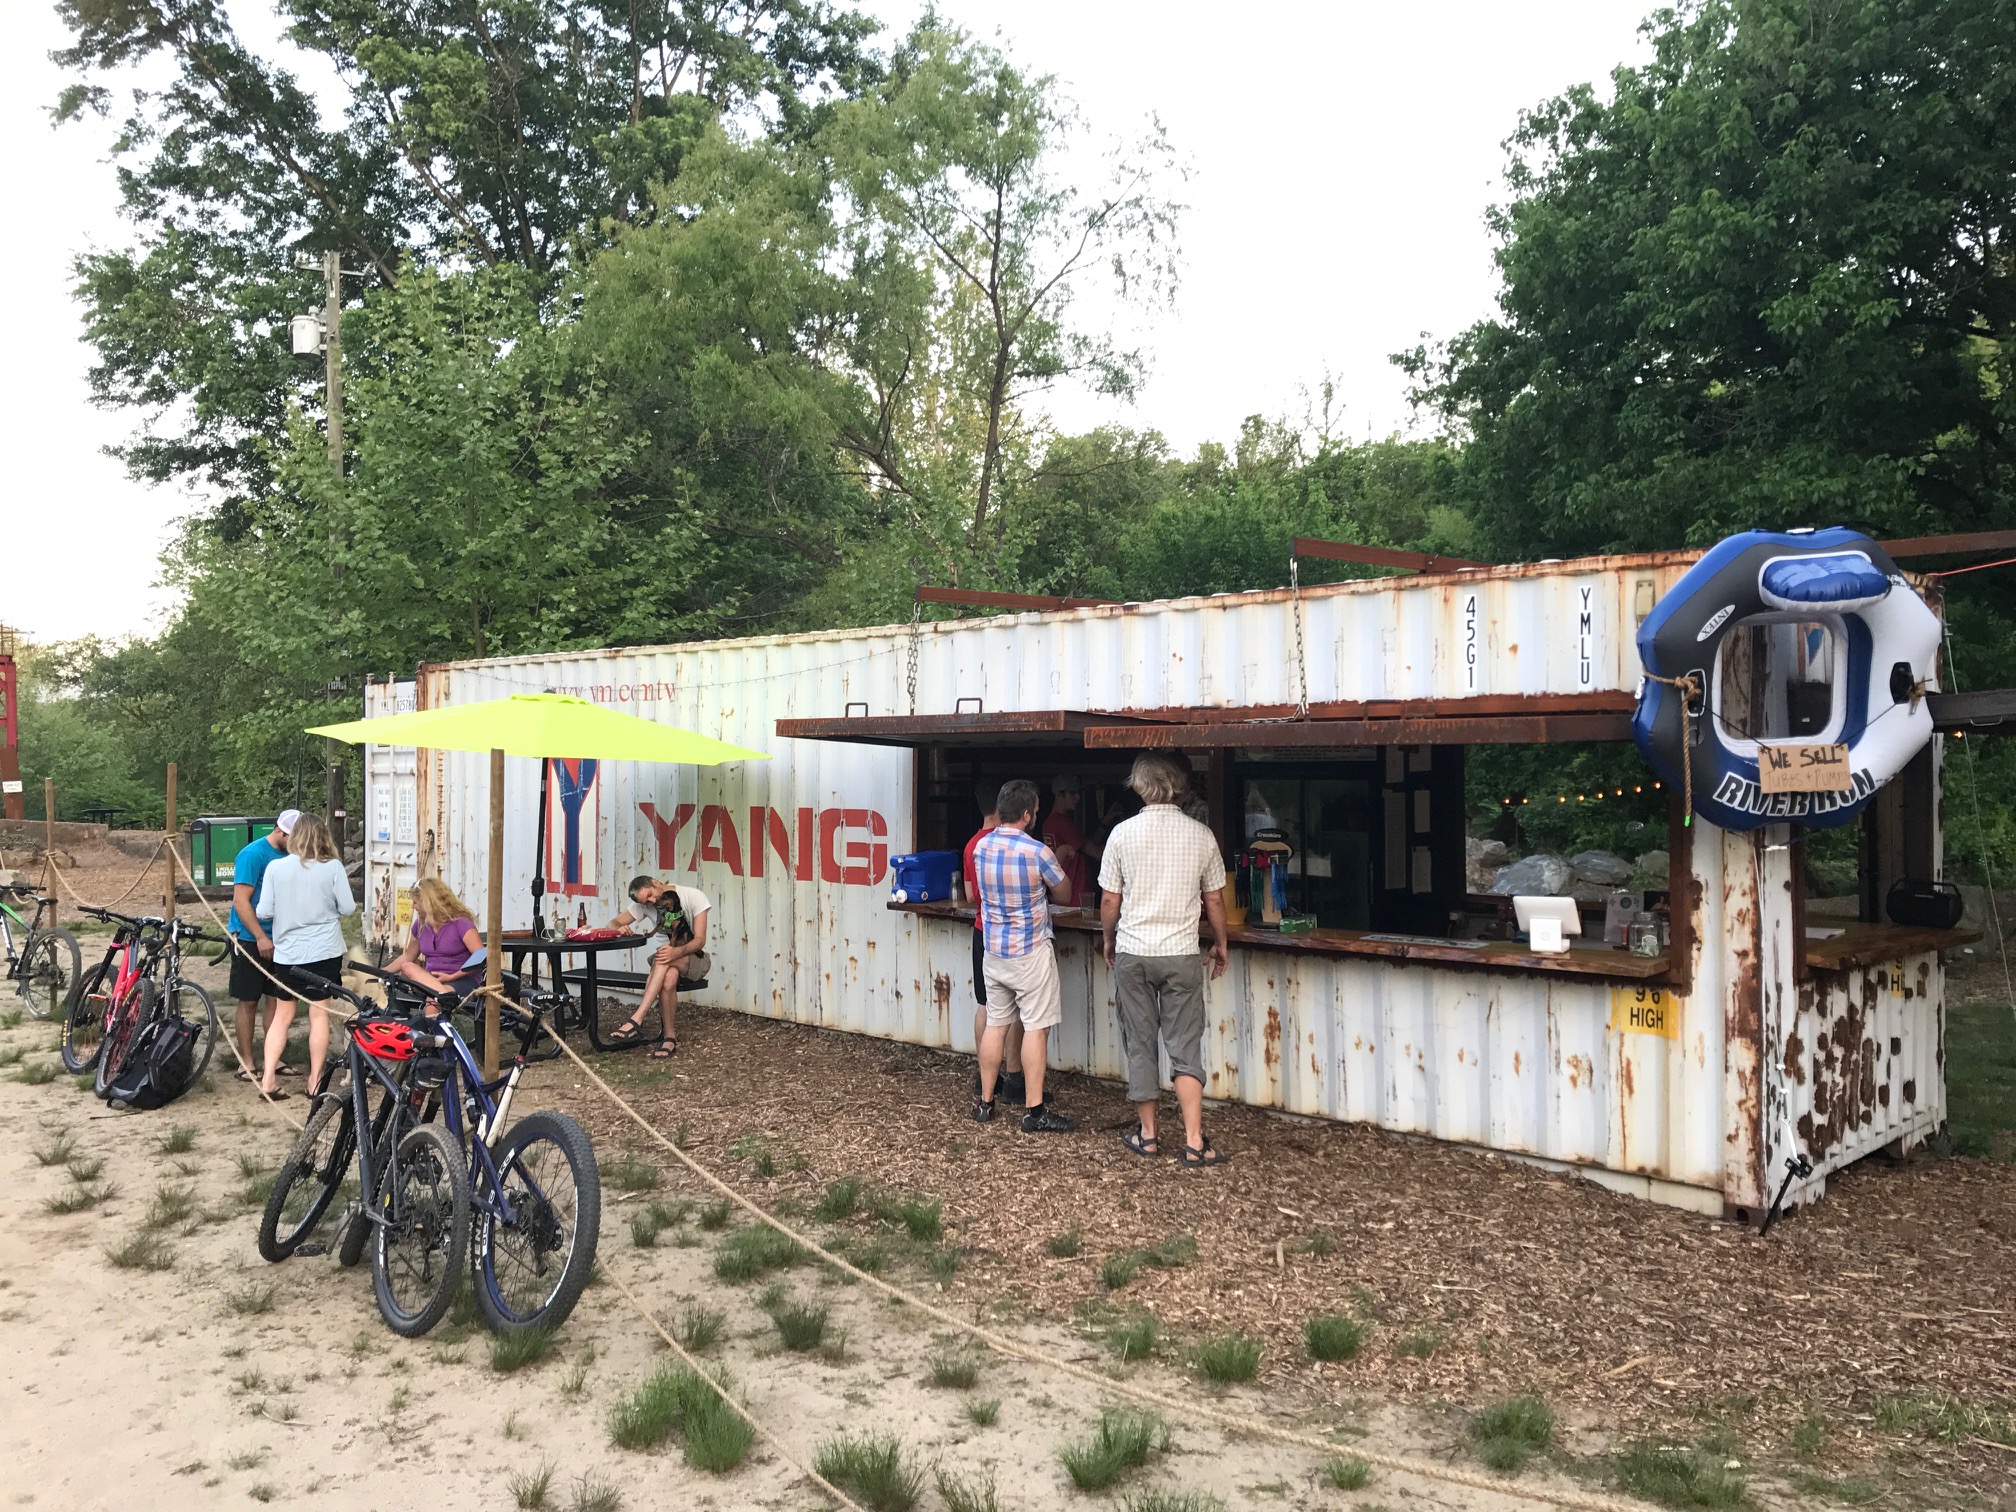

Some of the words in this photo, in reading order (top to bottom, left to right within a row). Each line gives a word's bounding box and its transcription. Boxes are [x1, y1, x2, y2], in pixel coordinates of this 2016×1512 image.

[1465, 596, 1476, 689] 45G1
[1580, 587, 1591, 685] YMLU
[1701, 608, 1730, 637] INTEX
[1768, 748, 1792, 769] WE
[1800, 746, 1842, 768] SELL
[638, 802, 889, 887] YANG
[1629, 1006, 1664, 1030] HIGH
[473, 1211, 484, 1271] KEND
